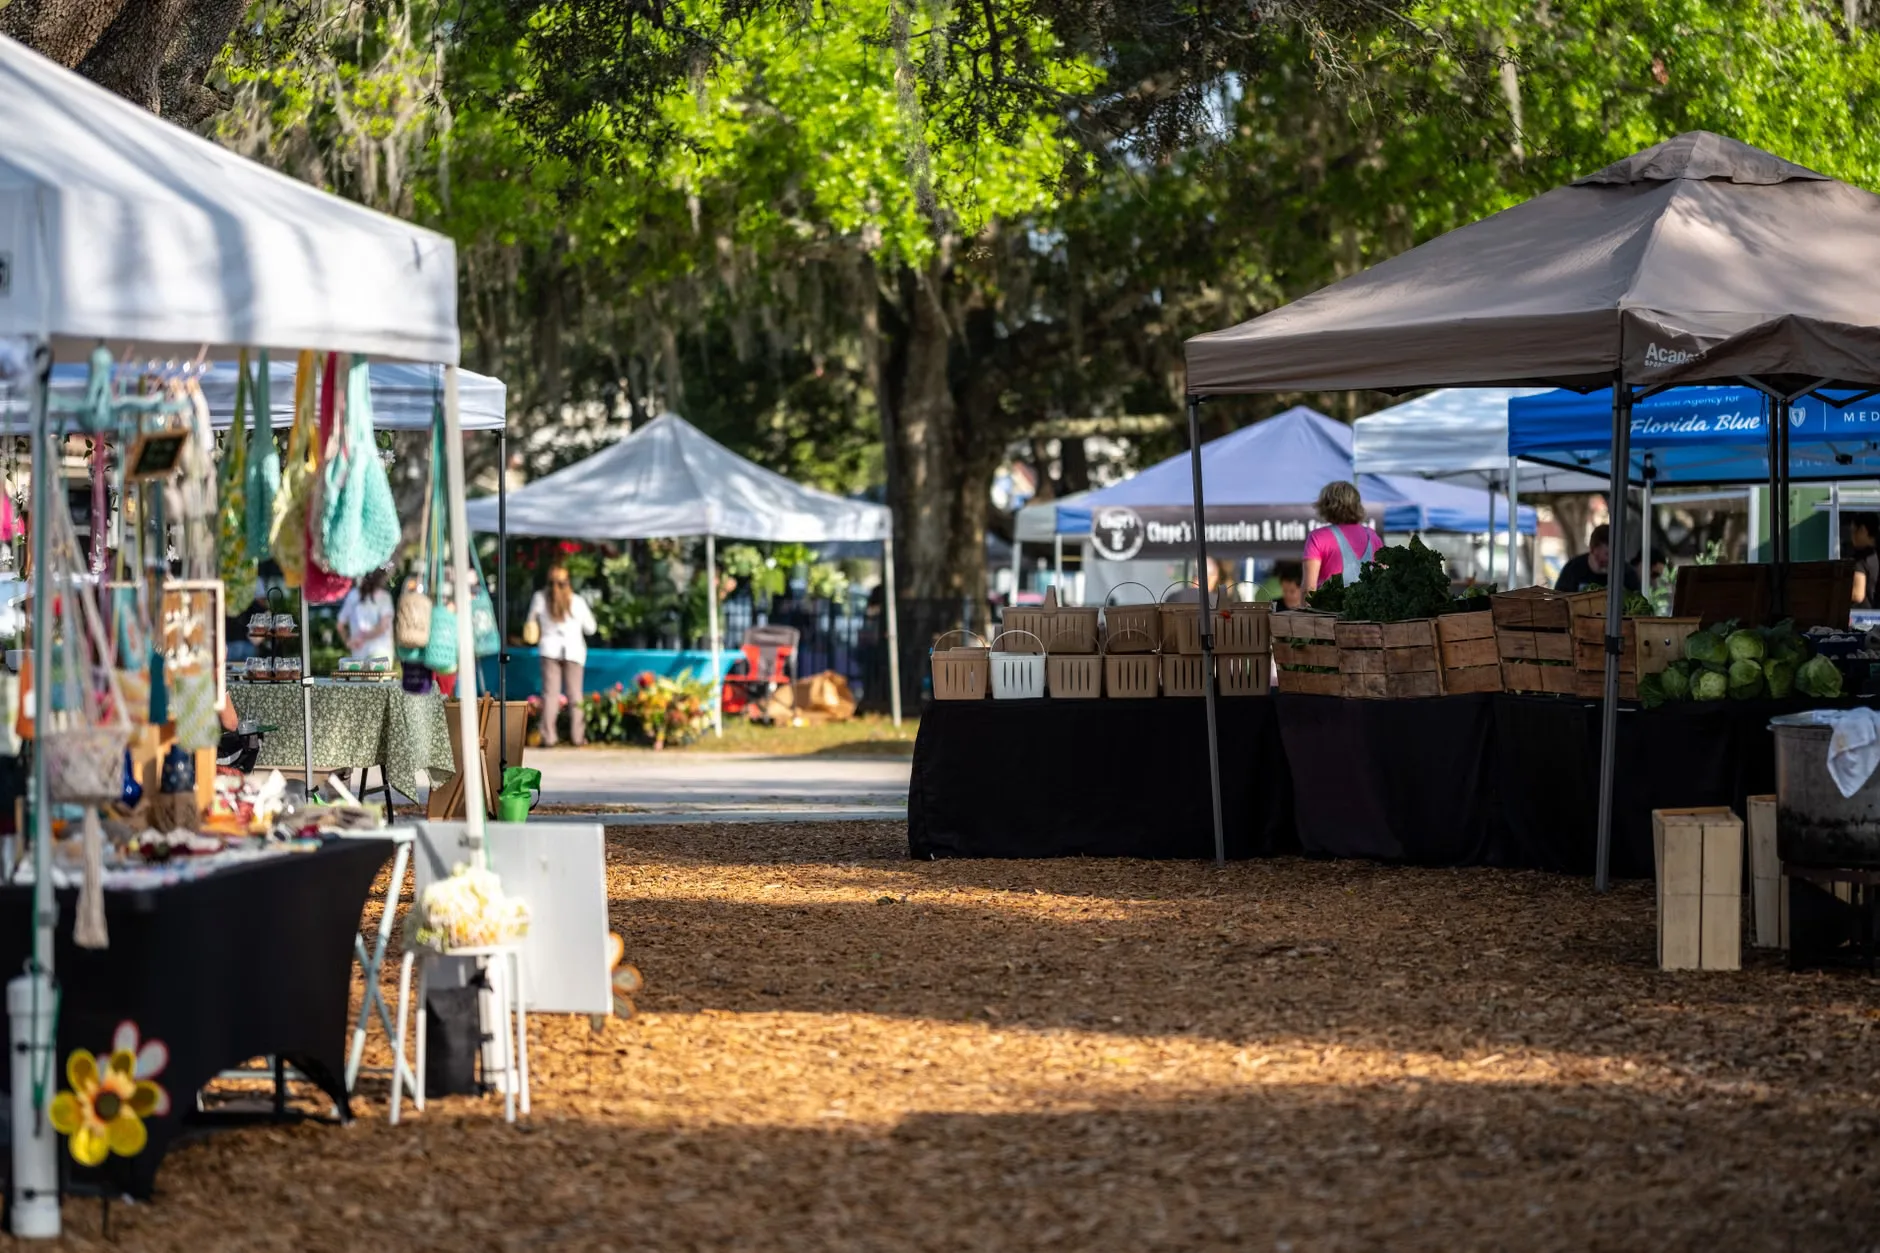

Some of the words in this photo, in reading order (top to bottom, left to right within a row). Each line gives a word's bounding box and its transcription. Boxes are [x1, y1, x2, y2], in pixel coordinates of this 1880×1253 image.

[1683, 396, 1723, 408] Agency
[1725, 394, 1741, 403] for
[1630, 413, 1710, 434] Florida
[1713, 411, 1760, 431] Blue
[1262, 519, 1273, 542] &
[1276, 519, 1305, 542] Latin
